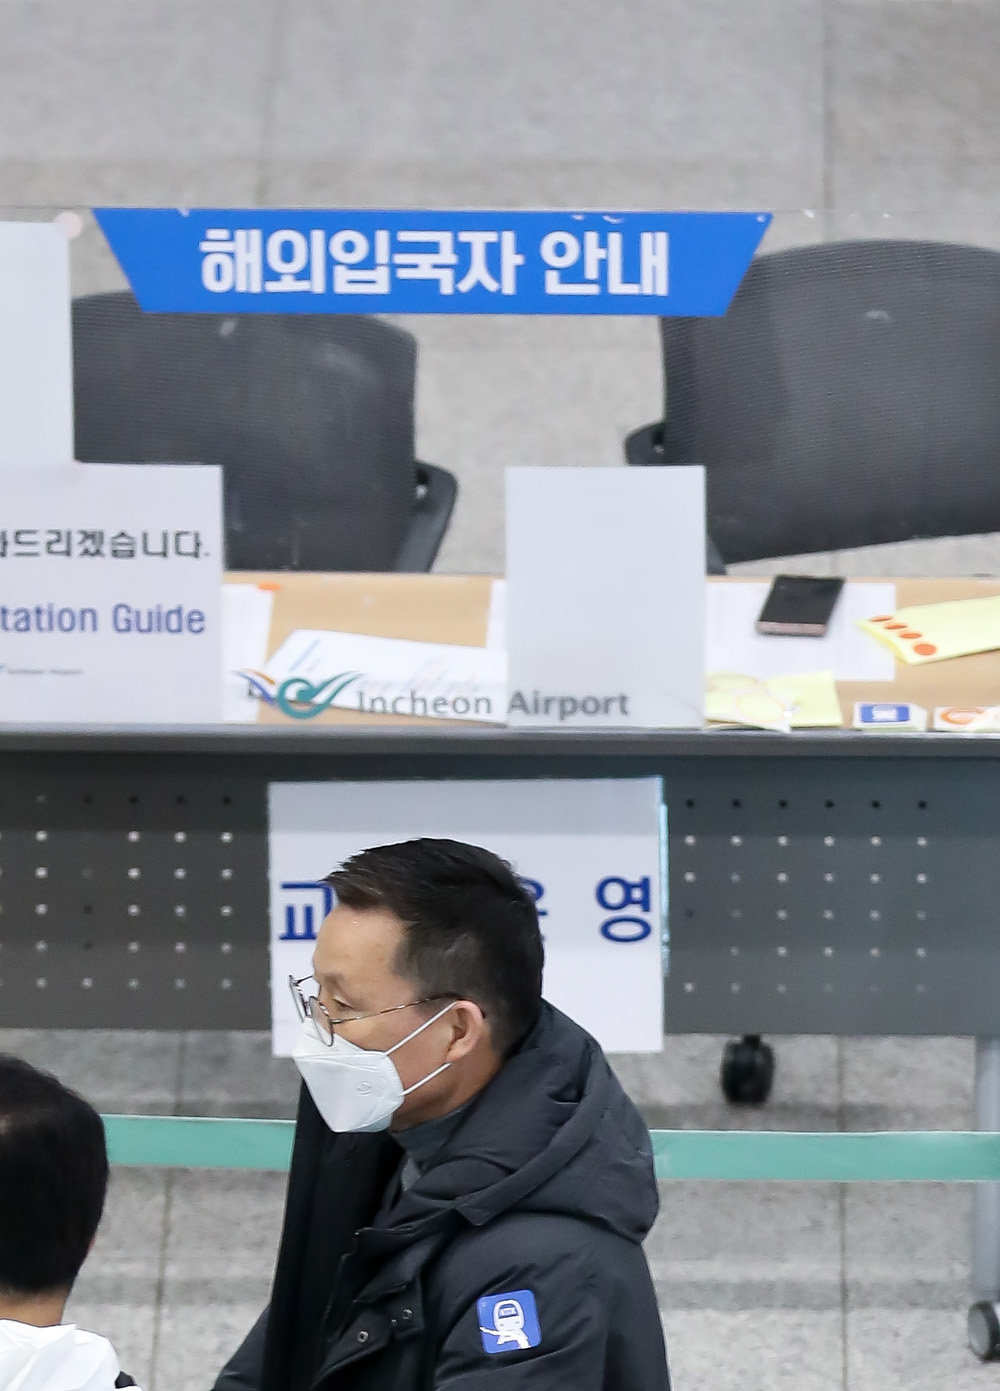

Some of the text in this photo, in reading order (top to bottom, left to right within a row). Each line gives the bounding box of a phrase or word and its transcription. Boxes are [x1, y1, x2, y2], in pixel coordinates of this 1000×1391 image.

[199, 227, 671, 297] 해외입국자 안내
[112, 603, 206, 635] Guide
[358, 689, 629, 721] Incheon Airport
